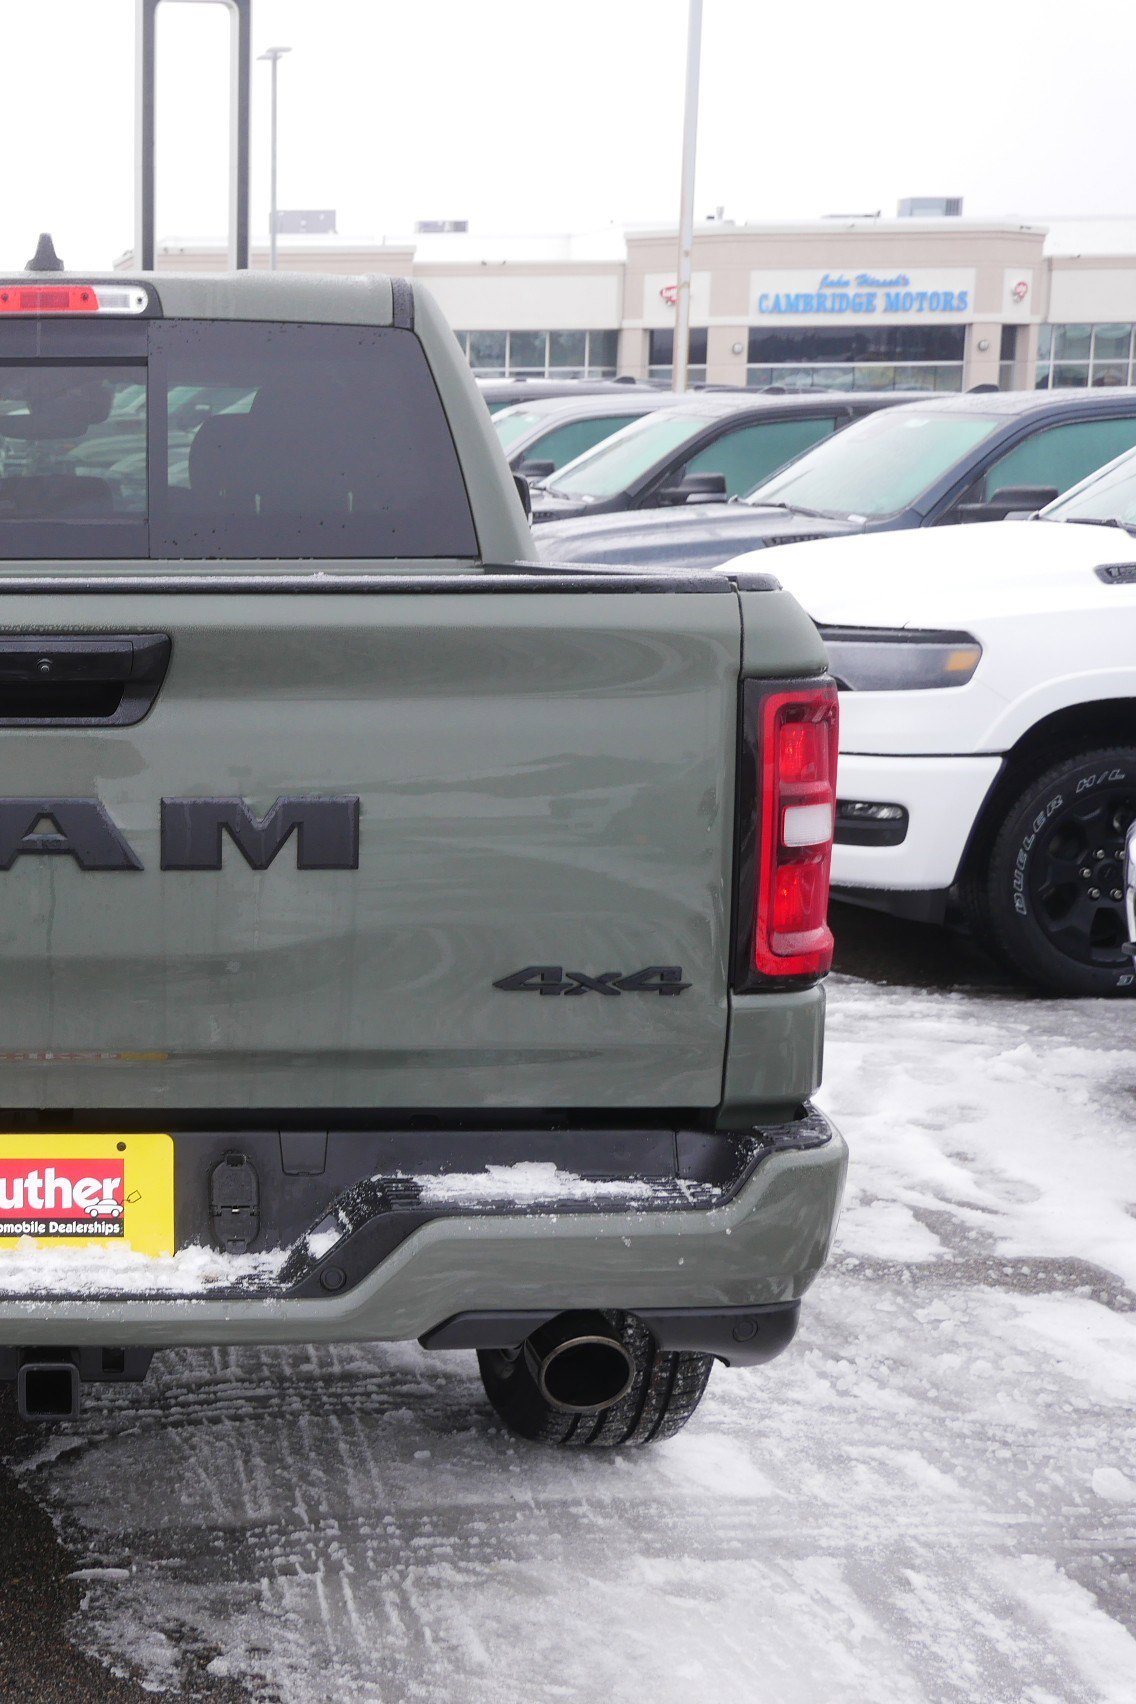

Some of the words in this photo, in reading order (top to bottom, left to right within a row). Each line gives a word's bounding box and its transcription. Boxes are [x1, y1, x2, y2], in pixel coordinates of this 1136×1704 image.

[758, 292, 877, 314] CAMBRIDGE
[882, 291, 968, 313] MOTORS
[1013, 794, 1063, 915] DUELER
[48, 1220, 121, 1235] Dealerships
